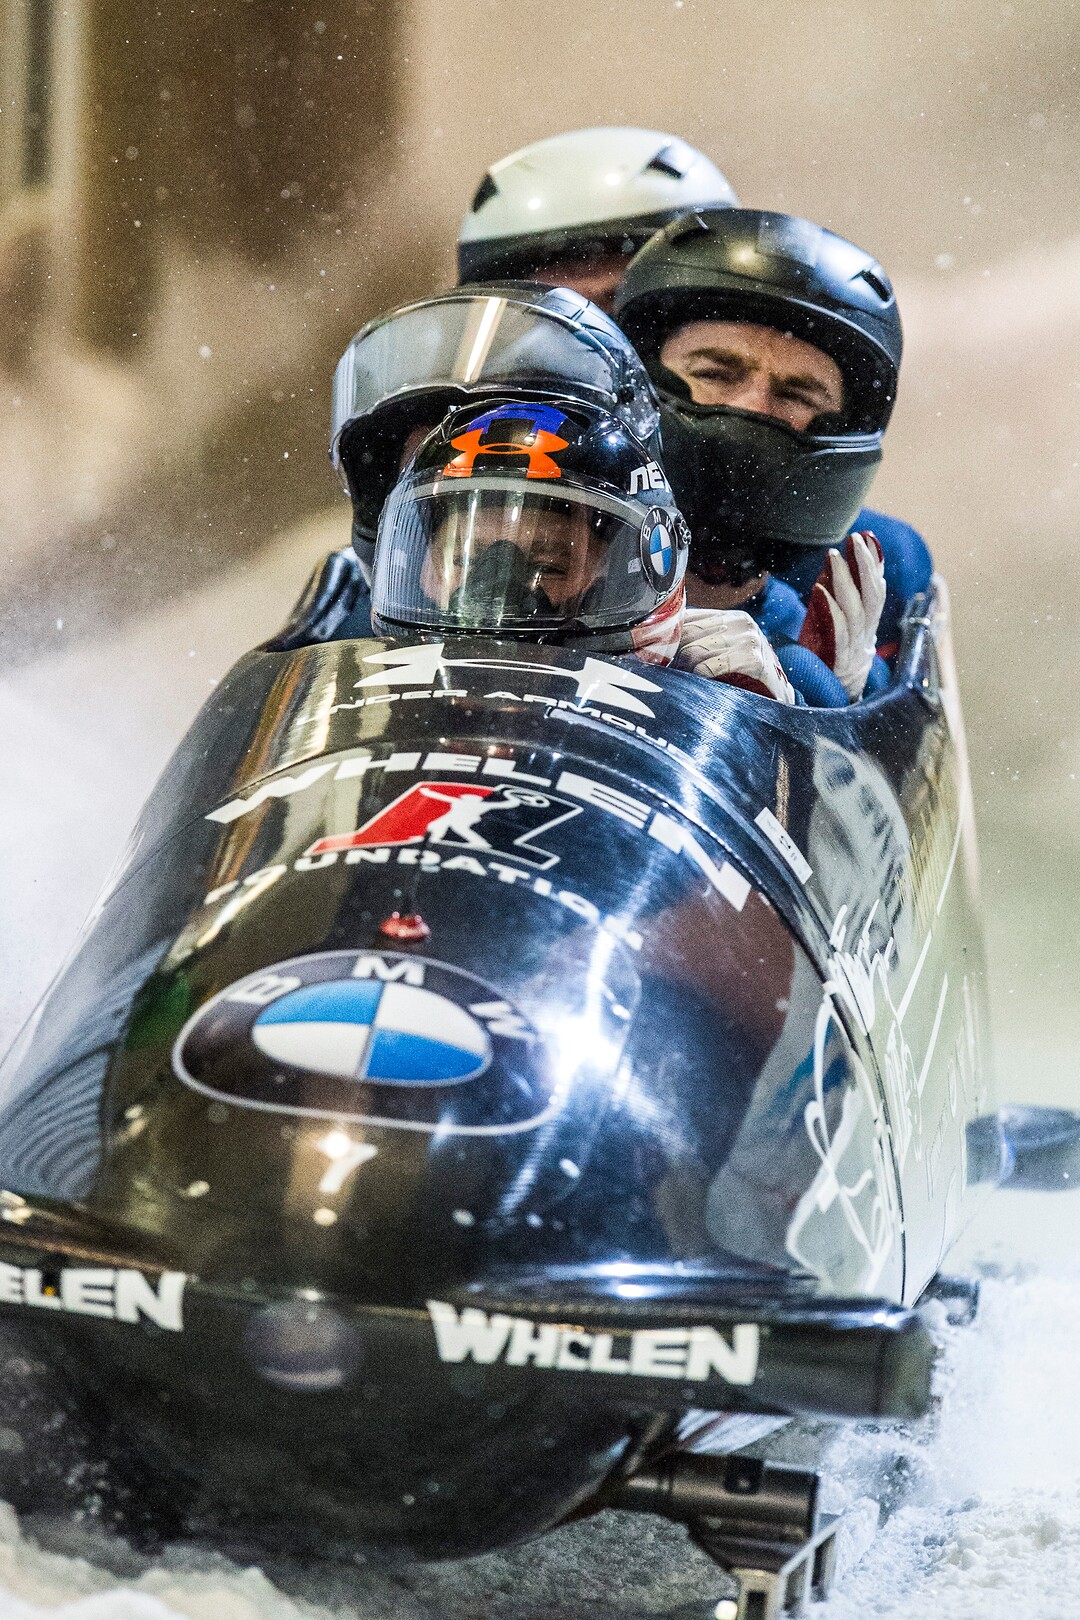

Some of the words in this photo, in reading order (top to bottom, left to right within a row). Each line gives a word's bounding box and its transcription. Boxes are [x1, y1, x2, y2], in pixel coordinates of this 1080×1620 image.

[642, 509, 674, 541] BMW
[205, 752, 752, 912] WHELEN
[226, 956, 540, 1042] BMW
[426, 1299, 760, 1386] WHELEN
